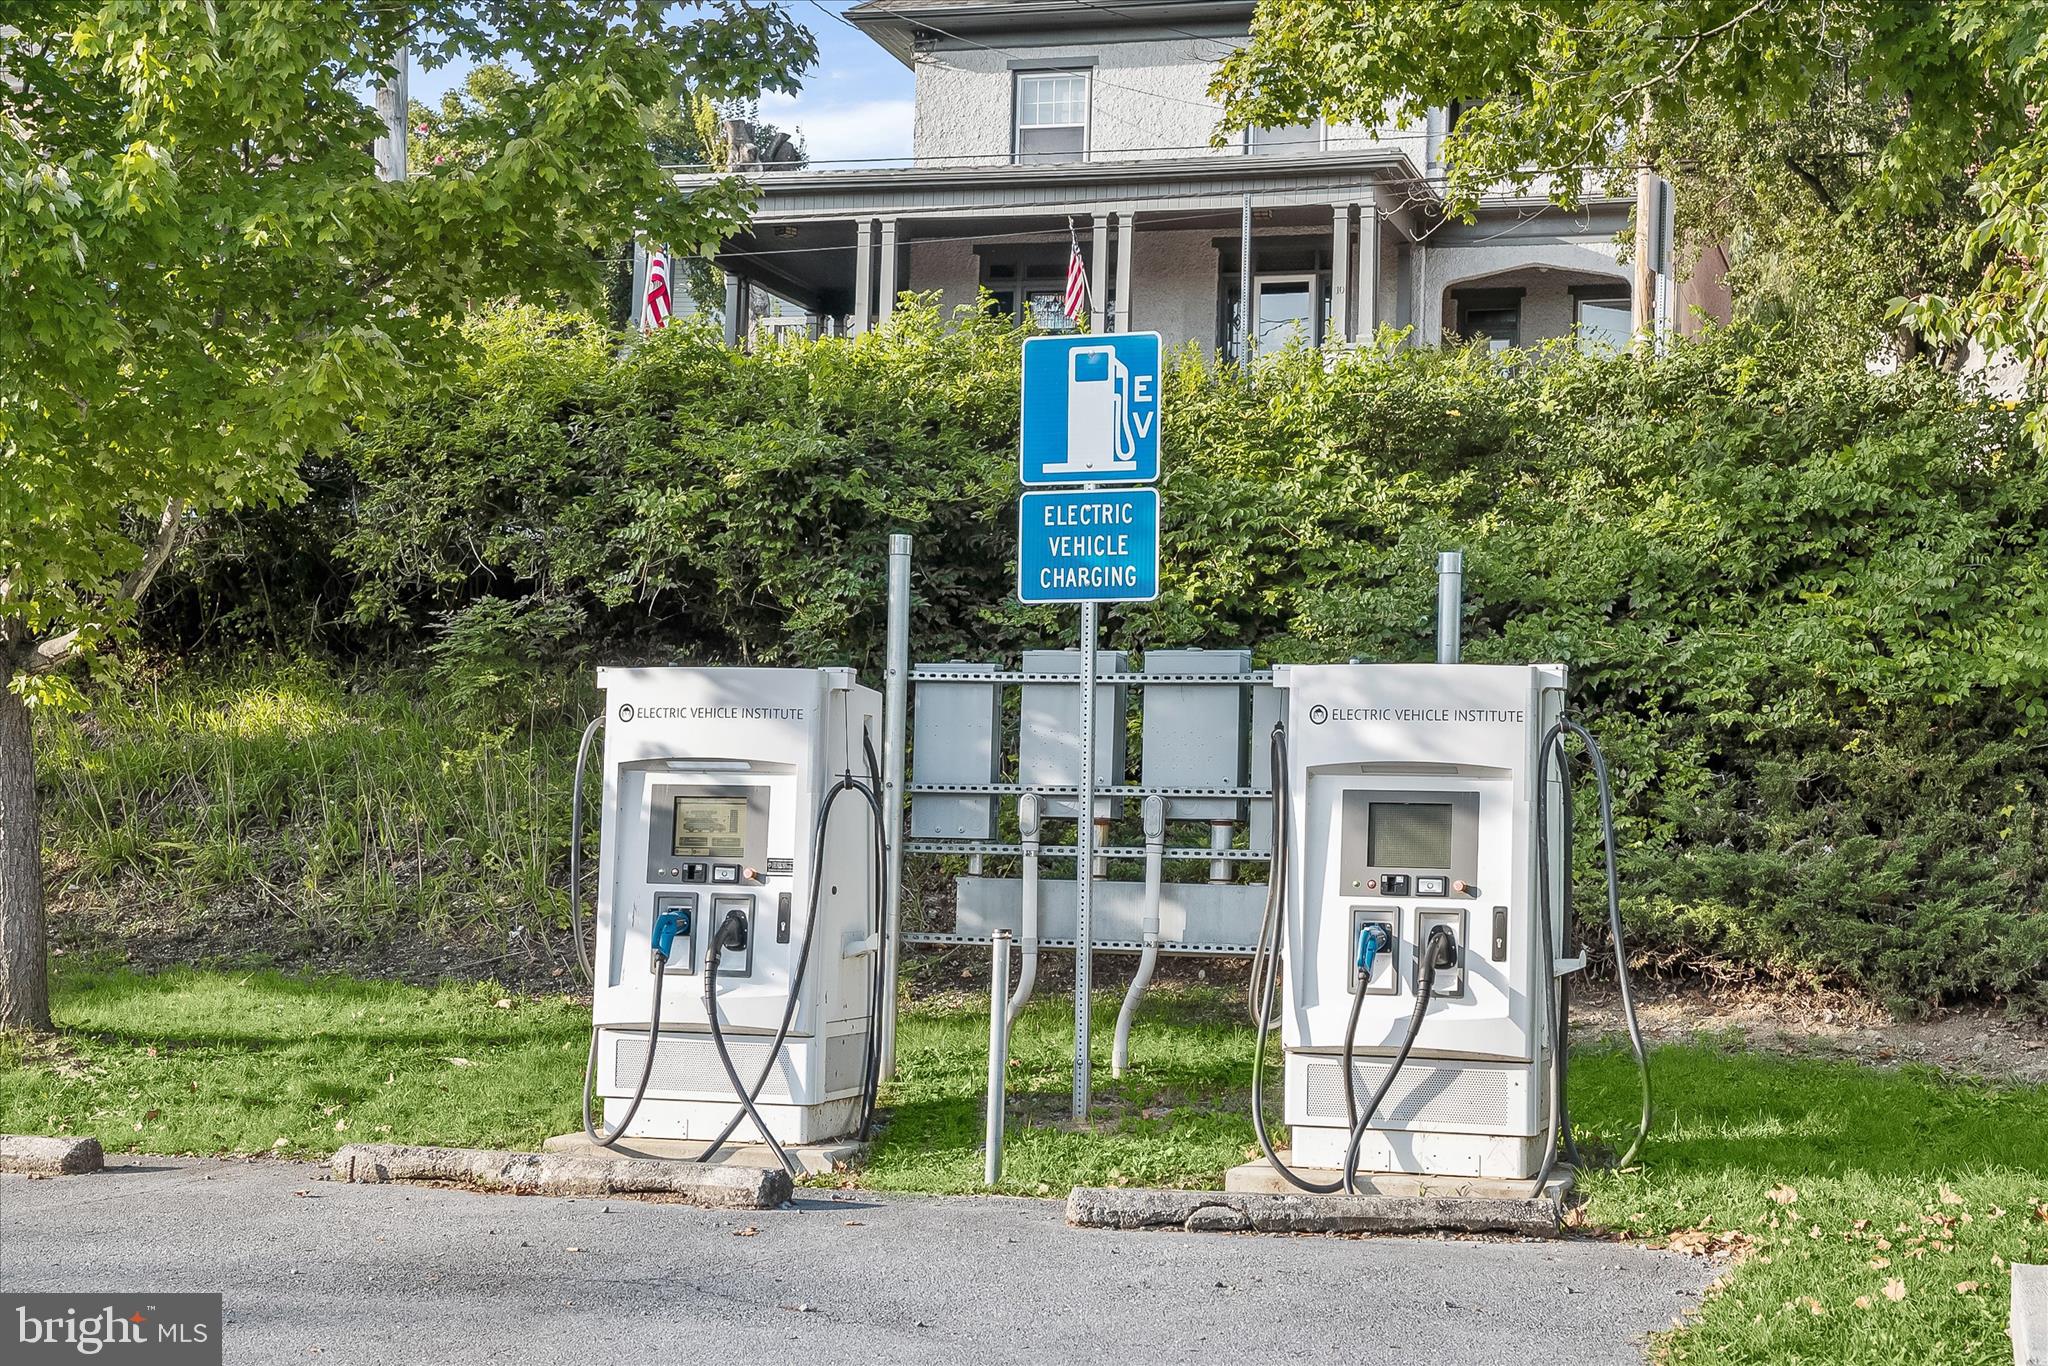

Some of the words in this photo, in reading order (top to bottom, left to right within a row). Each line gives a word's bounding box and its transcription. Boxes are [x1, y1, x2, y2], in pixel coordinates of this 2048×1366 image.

[1044, 503, 1133, 526] ELECTRIC
[1049, 534, 1129, 557] VEHICLE
[1040, 566, 1137, 589] CHARGING
[637, 707, 687, 719] ELECTRIC
[690, 707, 740, 719] VEHICLE
[741, 708, 804, 720] INSTITUTE
[1332, 708, 1391, 721] ELECTRIC
[1394, 709, 1449, 721] VEHICLE
[1454, 709, 1524, 723] INSTITUTE
